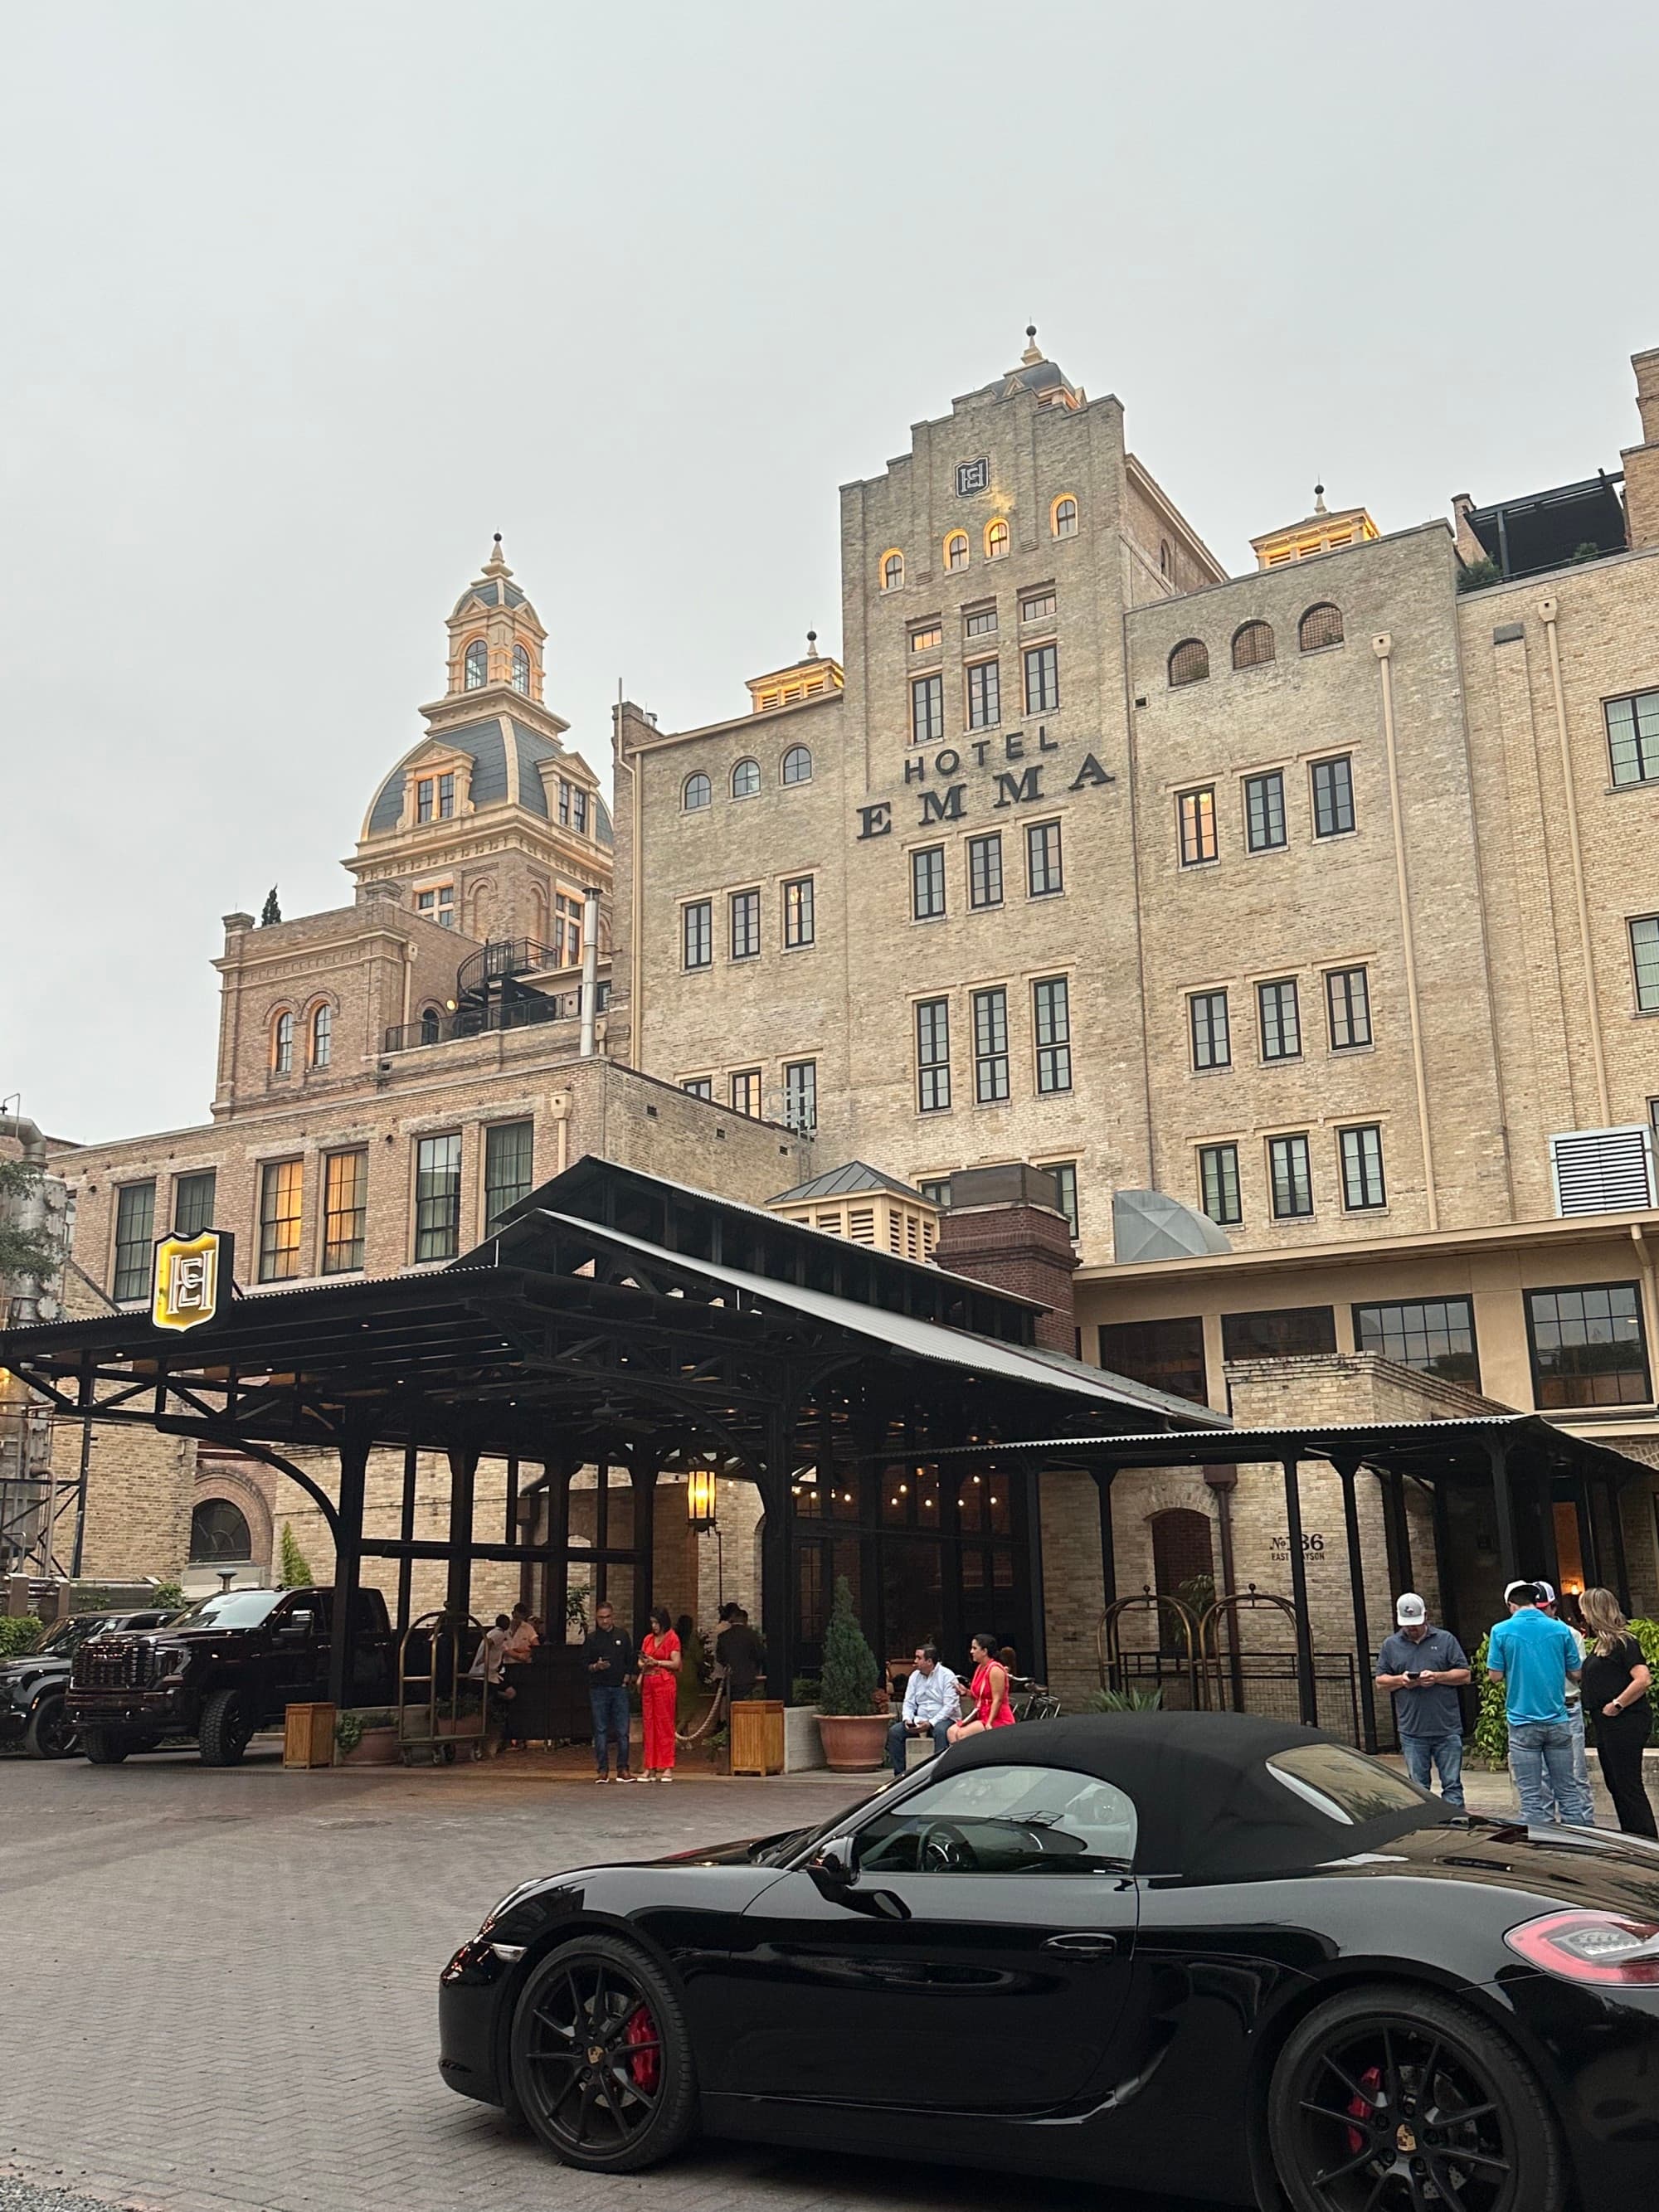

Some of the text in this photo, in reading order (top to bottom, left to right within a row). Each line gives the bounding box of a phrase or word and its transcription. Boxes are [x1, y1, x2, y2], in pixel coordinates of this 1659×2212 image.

[904, 726, 1058, 784] HOTEL
[857, 752, 1116, 839] EMMA
[1271, 1552, 1289, 1561] EAST
